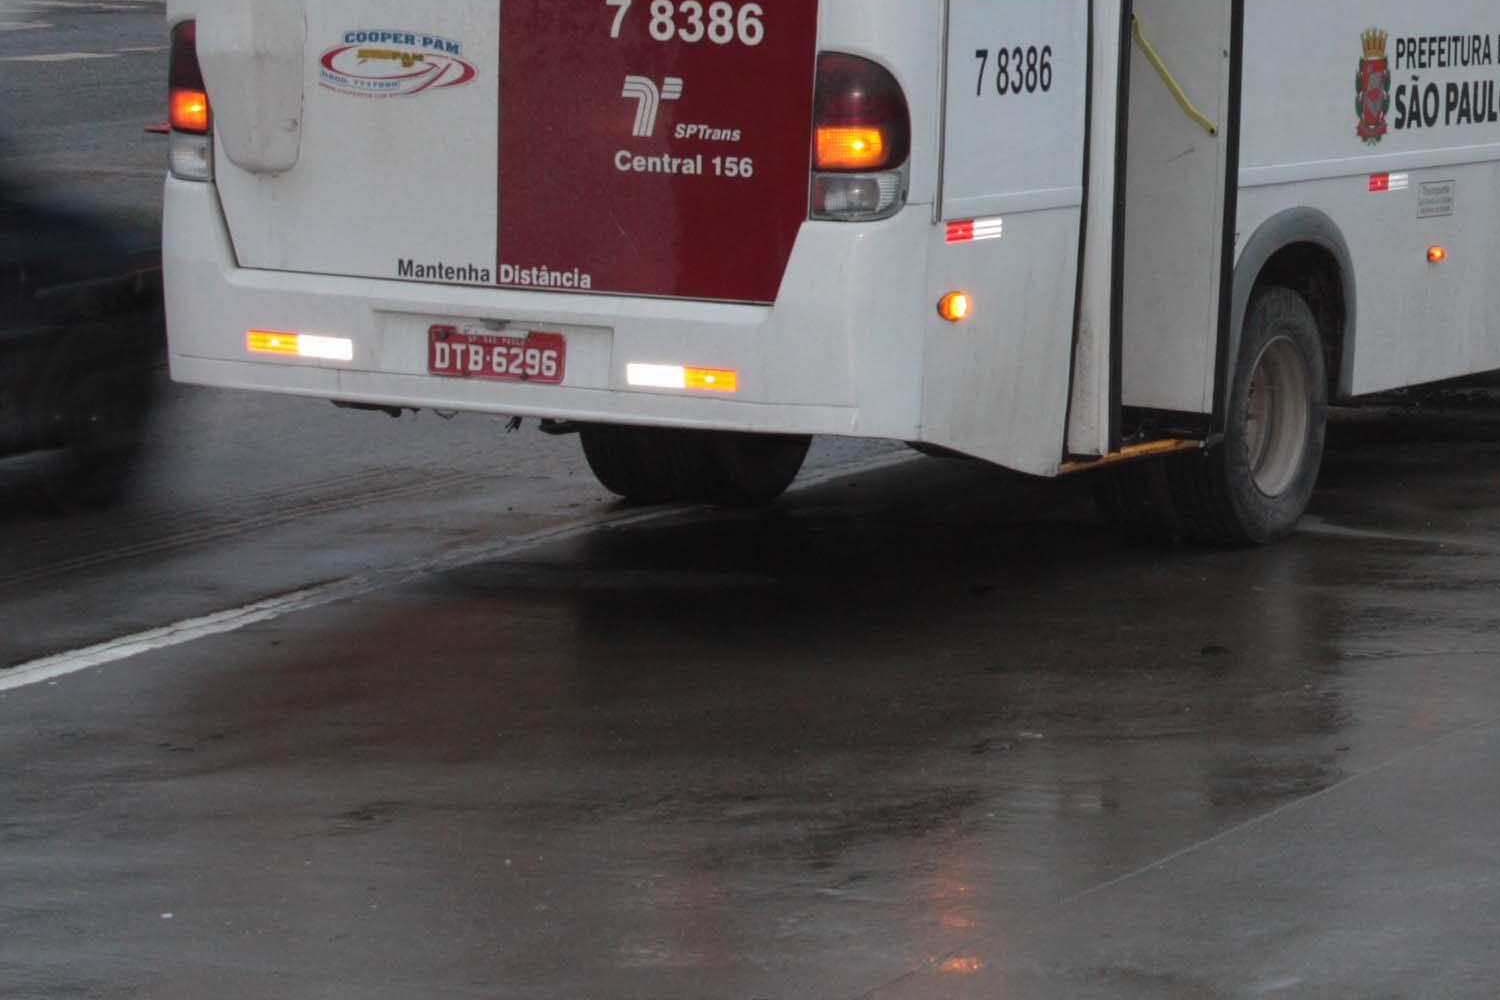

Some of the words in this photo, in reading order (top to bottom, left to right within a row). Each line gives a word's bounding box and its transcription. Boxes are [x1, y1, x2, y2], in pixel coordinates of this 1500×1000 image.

[1396, 34, 1492, 70] PREFEITURA
[975, 49, 988, 96] 7
[996, 45, 1052, 95] 8386
[1394, 75, 1440, 130] SÃO
[673, 123, 742, 142] SPTrans
[614, 150, 703, 175] Central
[712, 156, 754, 178] 156
[397, 259, 490, 282] Mantenha
[499, 264, 592, 288] Distância
